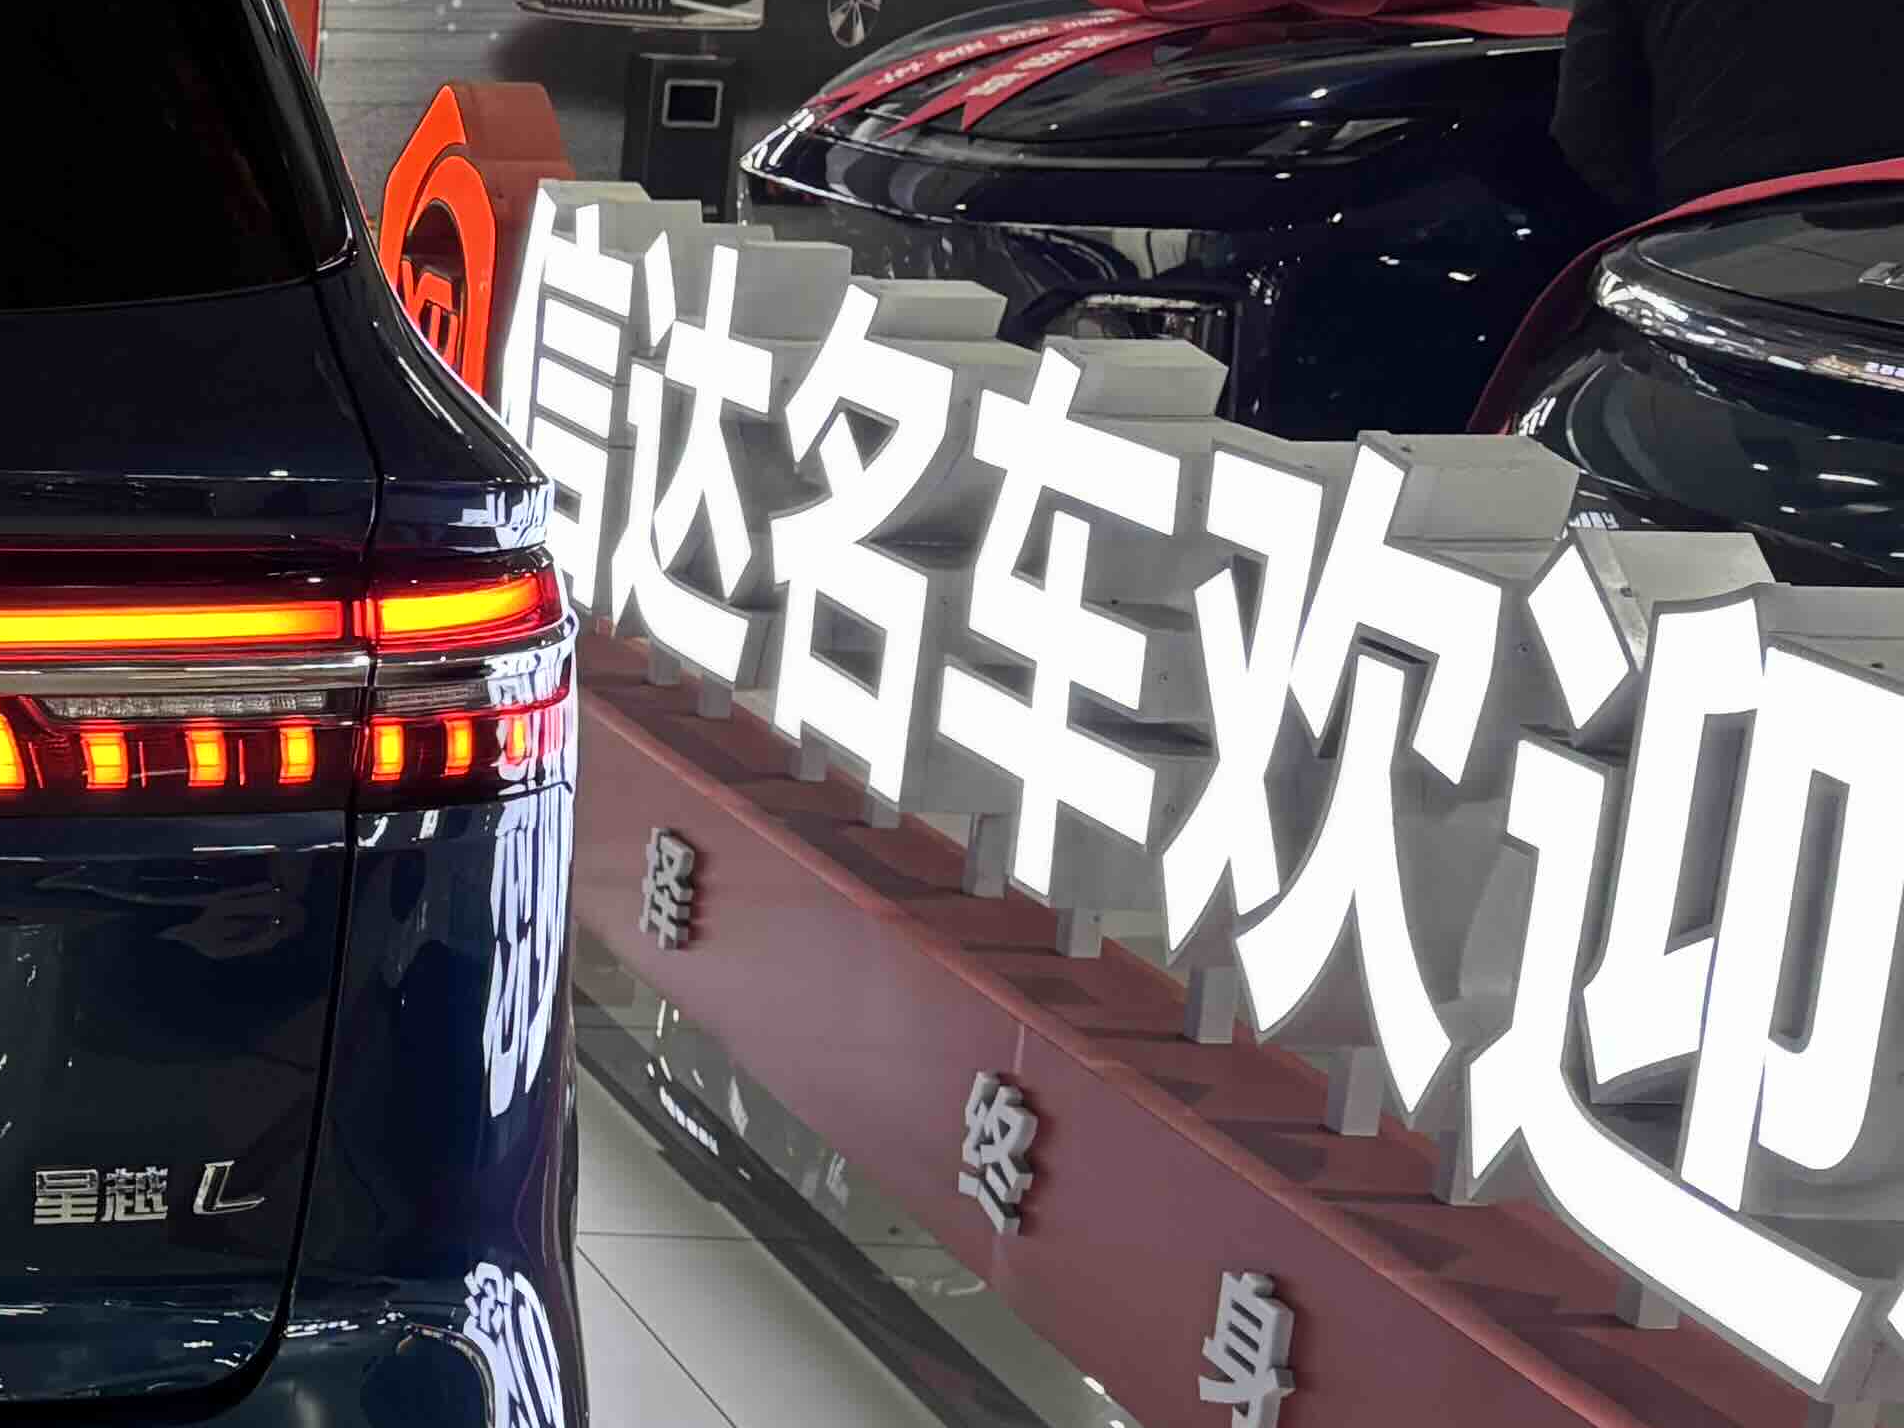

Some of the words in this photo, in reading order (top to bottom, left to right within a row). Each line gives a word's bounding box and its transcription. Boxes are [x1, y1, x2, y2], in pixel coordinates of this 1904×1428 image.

[498, 184, 1904, 1387] 信达名车欢迎
[33, 1168, 169, 1225] 星越
